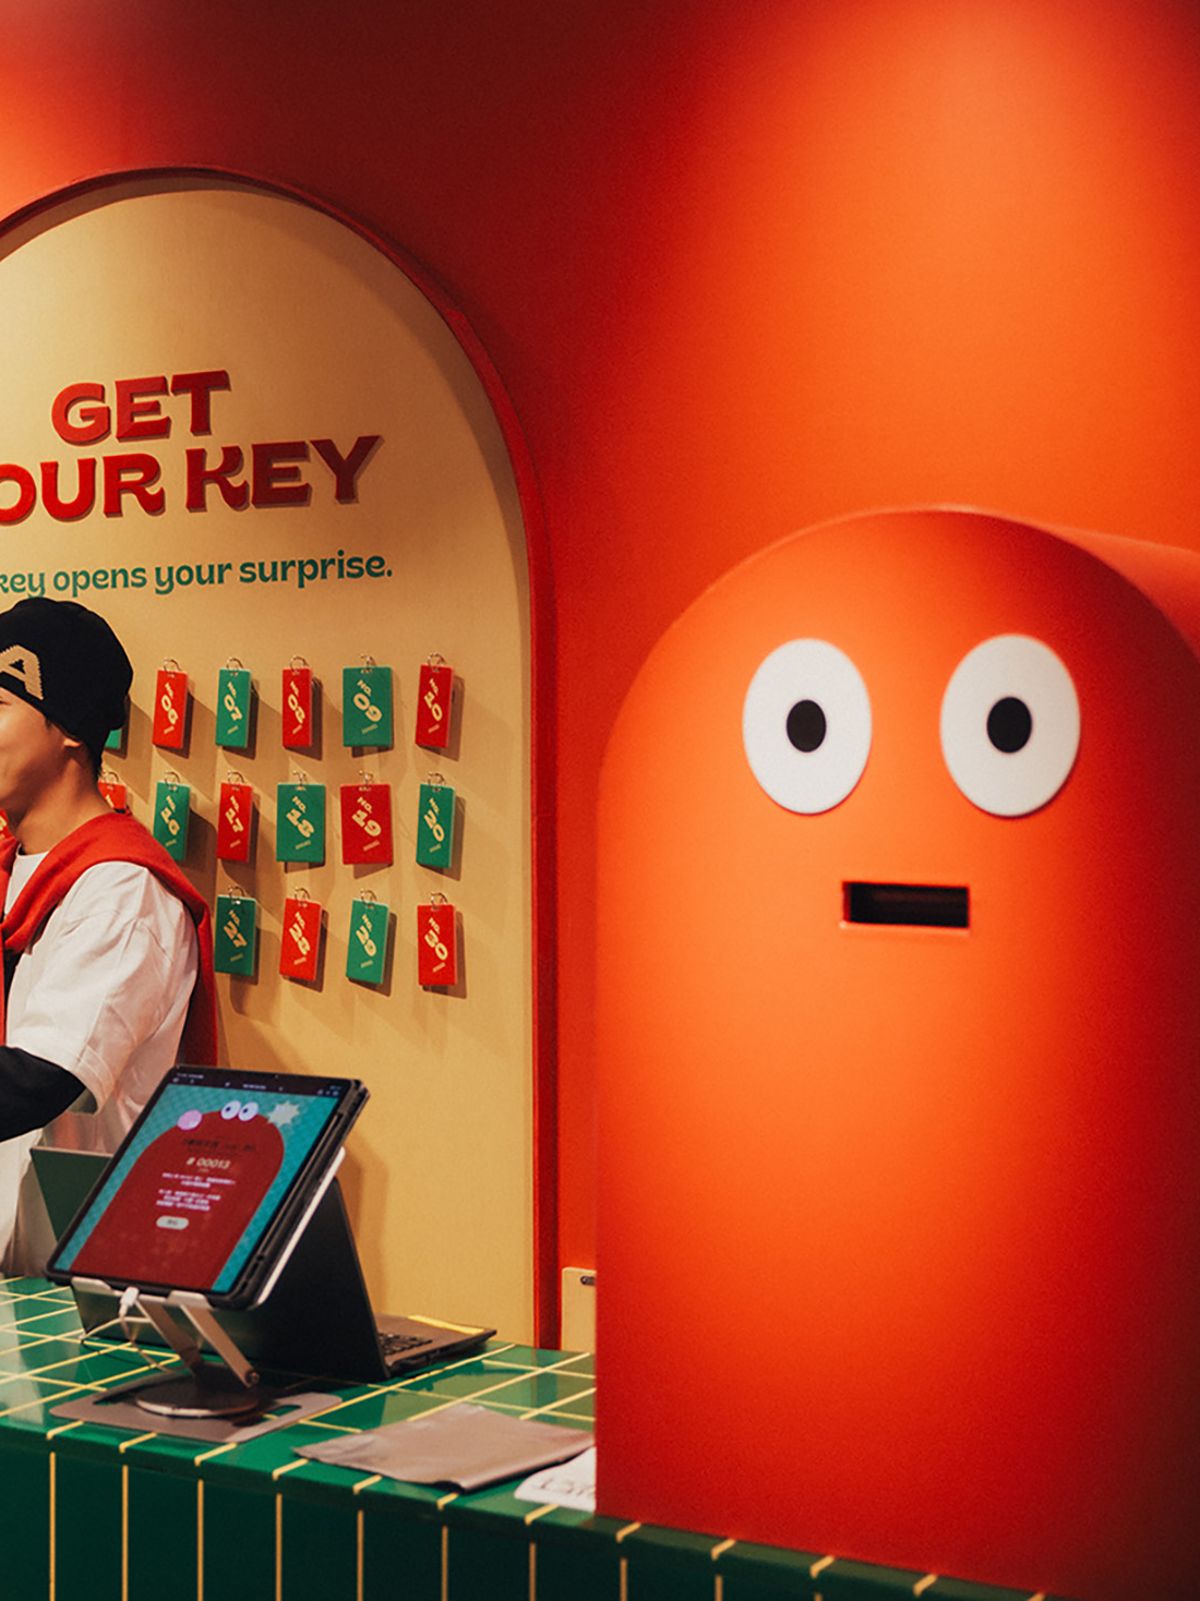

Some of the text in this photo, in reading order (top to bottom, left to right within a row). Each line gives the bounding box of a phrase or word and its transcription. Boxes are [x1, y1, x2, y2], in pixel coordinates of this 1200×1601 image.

[51, 370, 231, 447] GET
[185, 435, 384, 512] KEY
[53, 563, 147, 597] opens
[154, 557, 232, 594] your
[238, 549, 393, 588] surprise.
[161, 694, 179, 725] 06
[224, 694, 243, 721] 07
[288, 694, 306, 724] 08
[353, 693, 382, 722] 09
[424, 691, 443, 721] 10
[161, 807, 180, 836] 16
[225, 807, 244, 832] 17
[286, 809, 315, 838] 18
[352, 809, 382, 837] 19
[423, 809, 445, 842] 20
[223, 921, 248, 948] 27
[289, 923, 311, 955] 28
[355, 925, 377, 957] 29
[424, 929, 448, 961] 30
